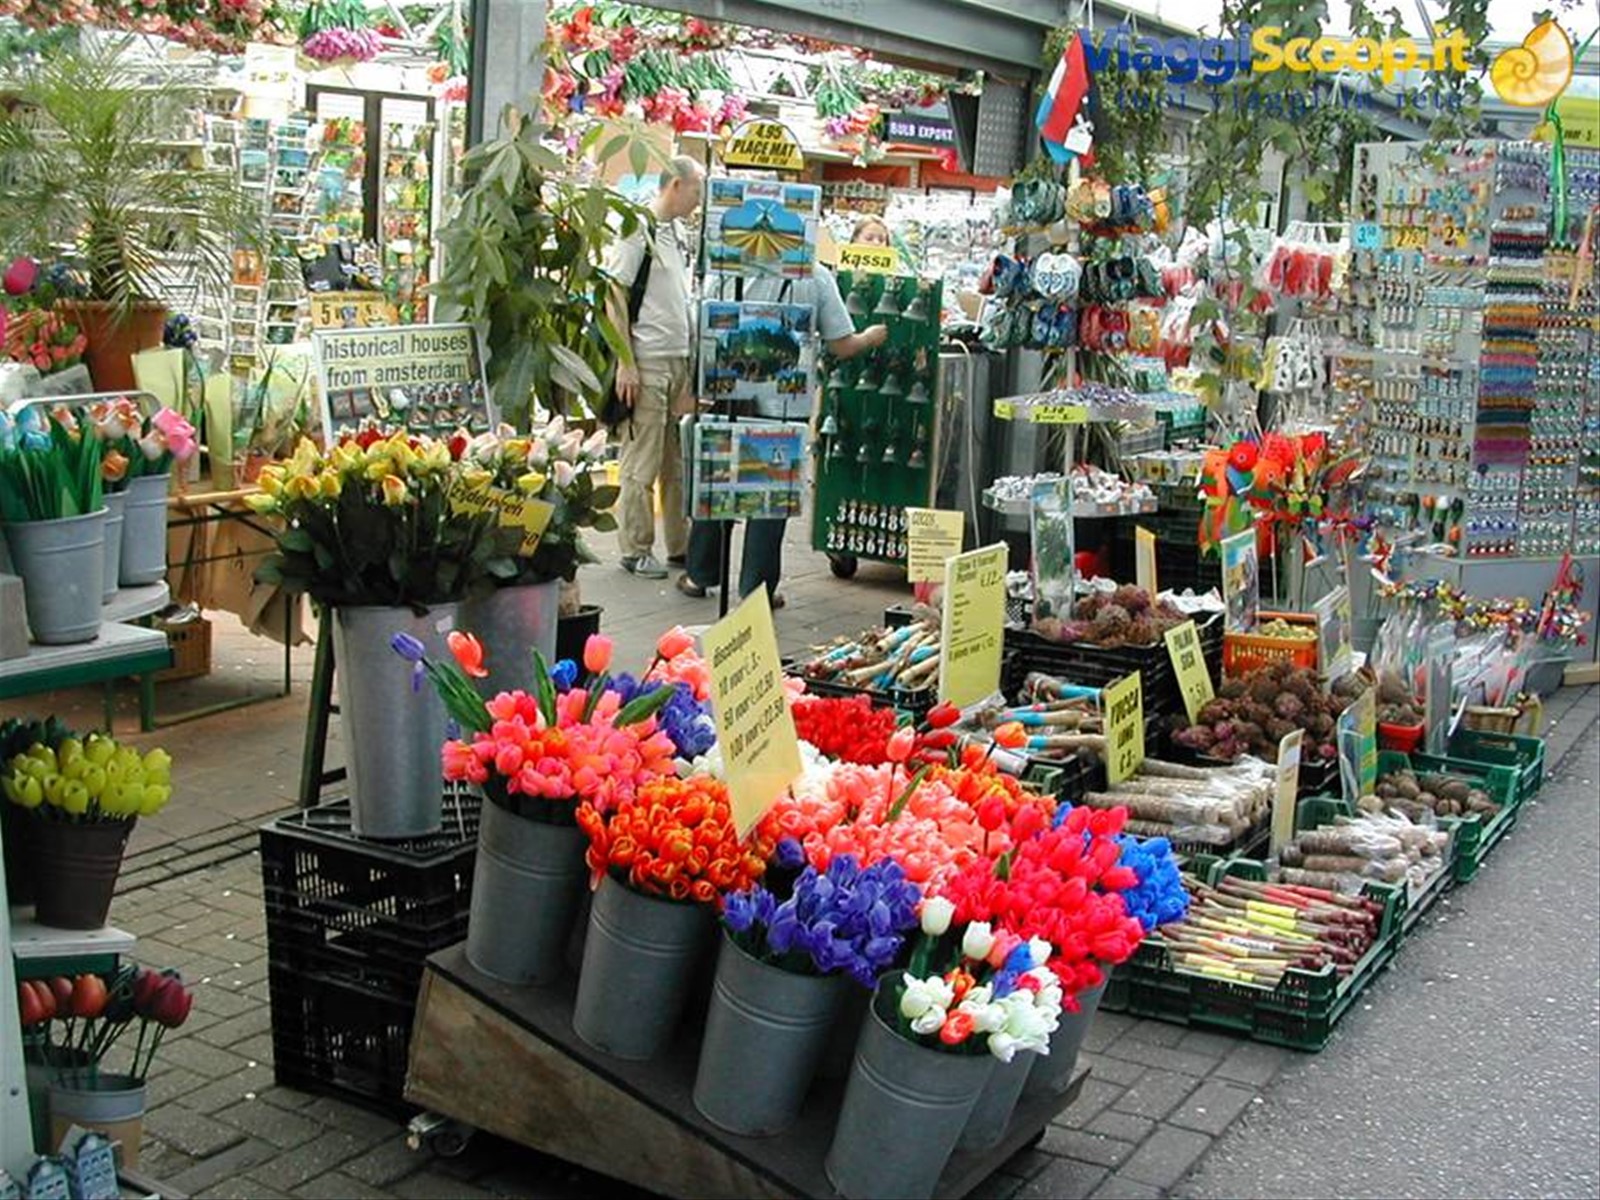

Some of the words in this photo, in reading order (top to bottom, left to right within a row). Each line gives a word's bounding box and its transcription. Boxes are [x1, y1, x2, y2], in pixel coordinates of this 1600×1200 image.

[889, 122, 916, 137] BULB
[918, 126, 954, 141] EXPORT
[732, 139, 768, 156] PLACE
[769, 142, 796, 158] MAT
[840, 250, 892, 268] kassa
[322, 334, 405, 360] historical
[411, 334, 468, 353] houses
[327, 366, 367, 388] from
[375, 360, 464, 383] amsterdam
